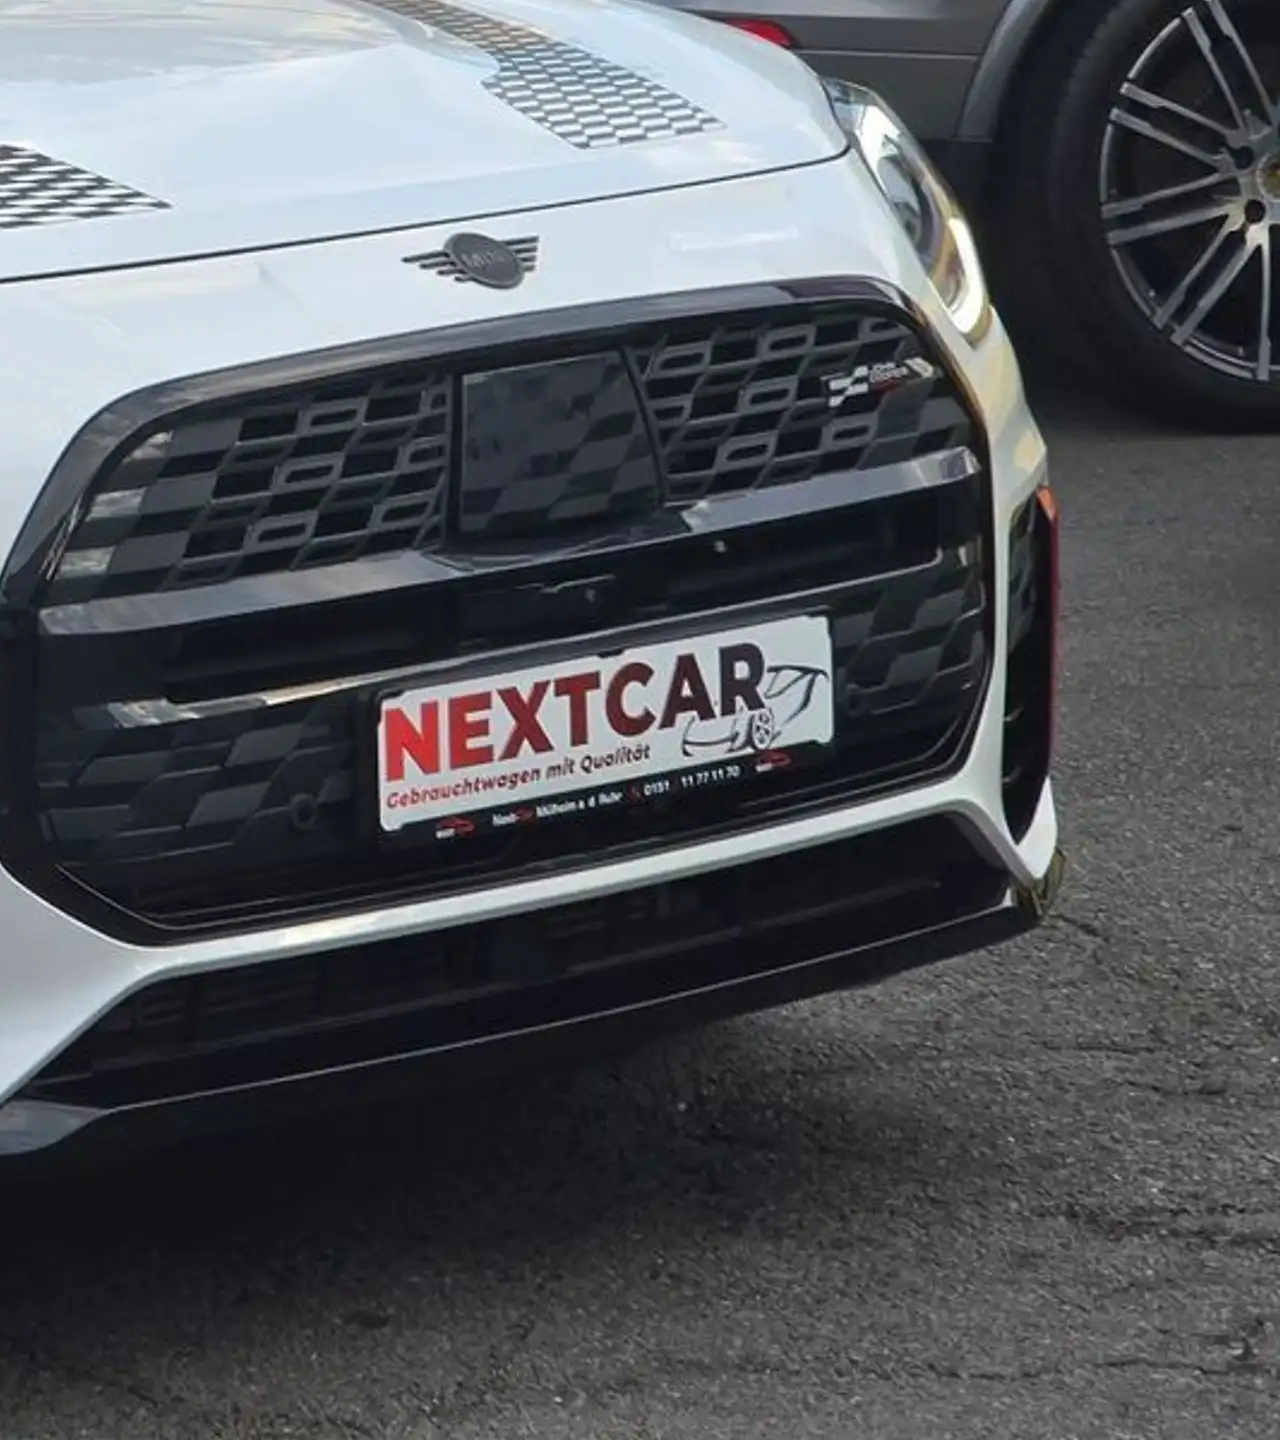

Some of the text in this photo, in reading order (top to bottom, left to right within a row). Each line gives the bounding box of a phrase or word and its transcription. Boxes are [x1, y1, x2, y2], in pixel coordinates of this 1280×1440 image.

[384, 641, 766, 782] NEXTCAR
[386, 744, 651, 809] Gebrauchtwagen mit Qualität
